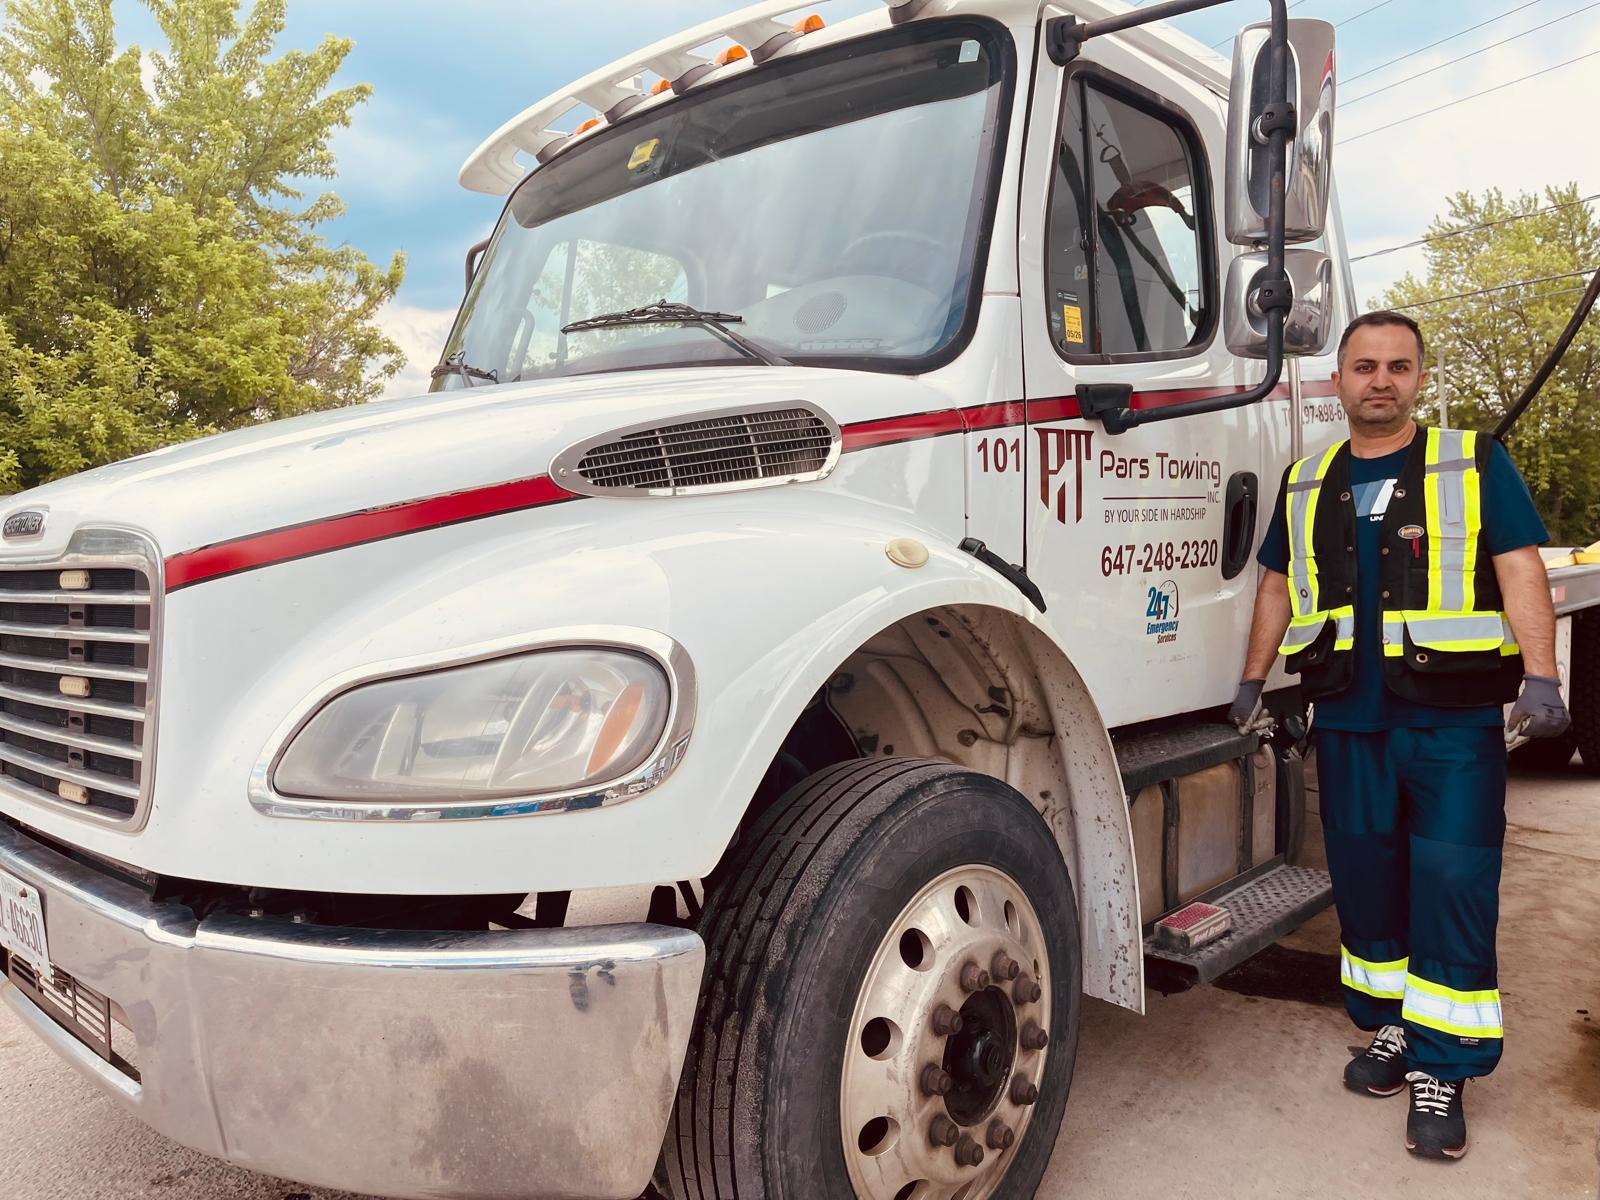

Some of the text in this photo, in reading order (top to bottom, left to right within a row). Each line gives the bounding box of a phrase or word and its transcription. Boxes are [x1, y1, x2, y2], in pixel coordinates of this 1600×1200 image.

[977, 437, 1021, 473] 101
[1100, 449, 1221, 488] Pars Towing
[1104, 507, 1207, 523] BY YOUR SIDE IN HARDSHIP
[1101, 539, 1218, 577] 647-248-2320
[1146, 620, 1179, 635] Emergency
[1157, 633, 1177, 644] Services
